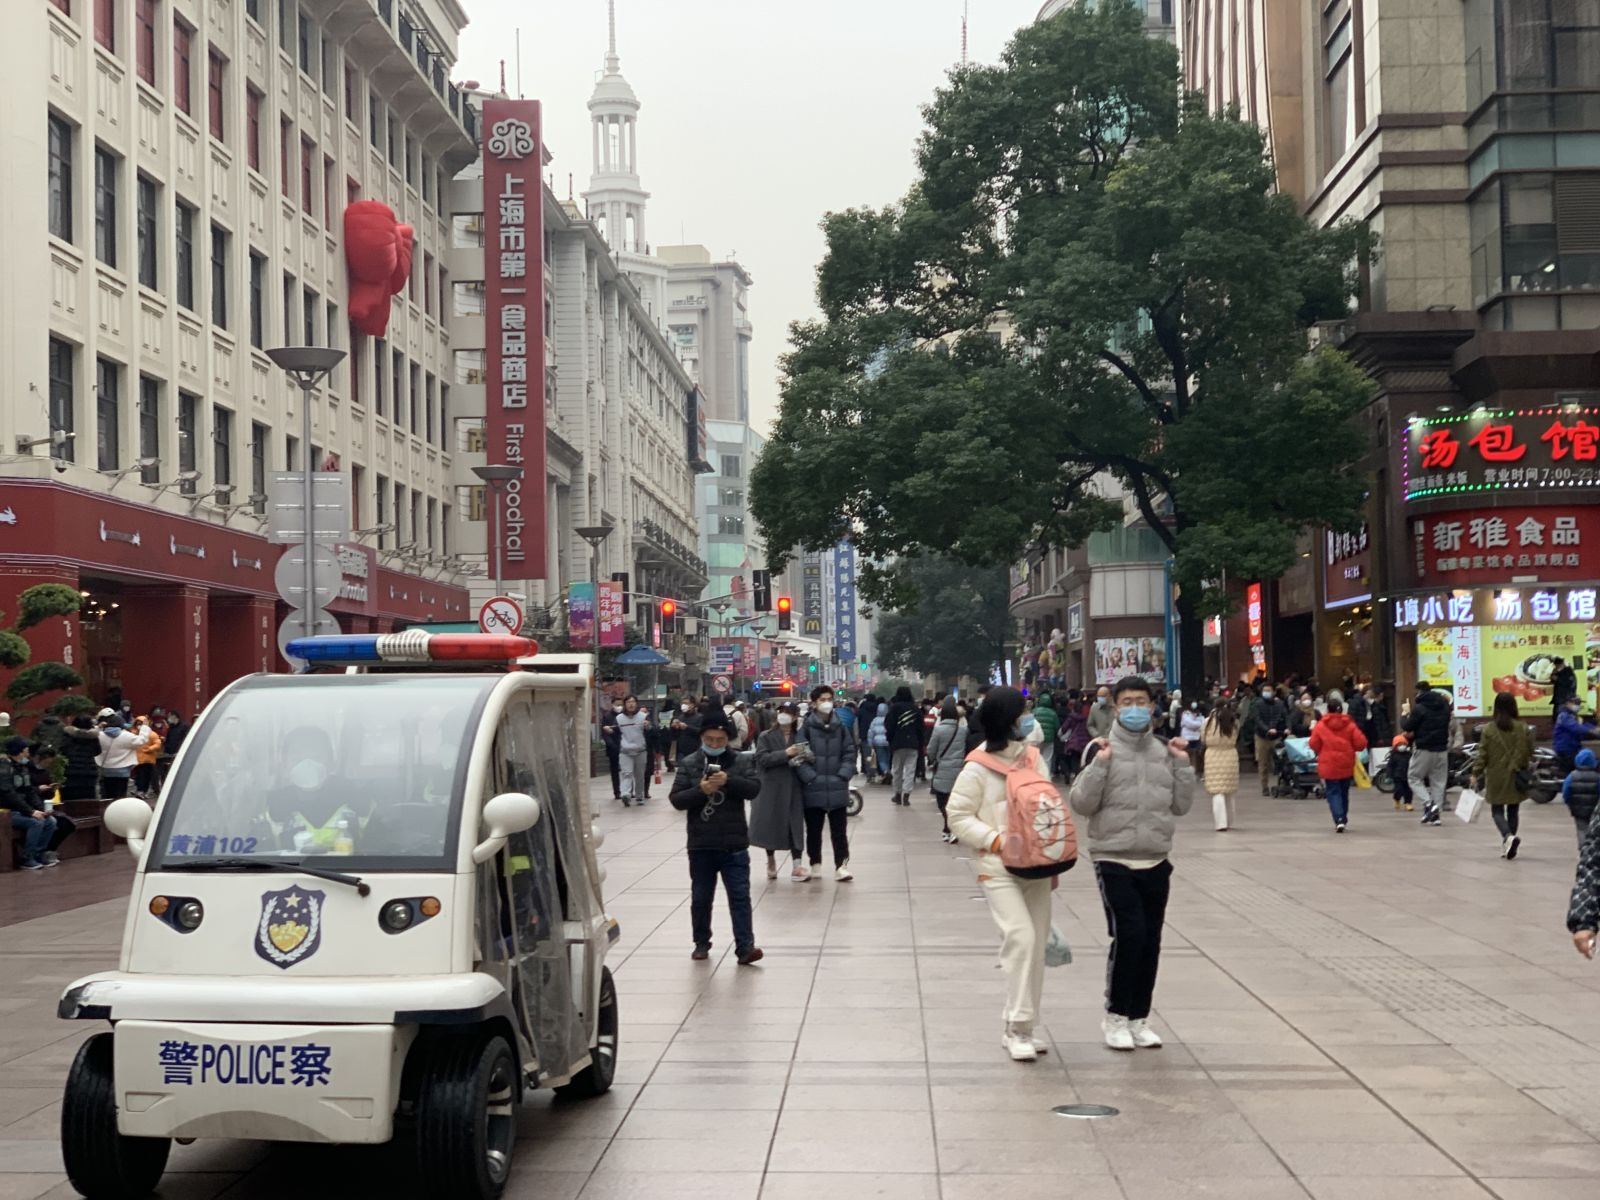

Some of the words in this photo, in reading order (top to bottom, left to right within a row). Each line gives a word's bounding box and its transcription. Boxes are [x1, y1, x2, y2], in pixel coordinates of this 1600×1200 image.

[500, 173, 527, 408] 上海市第一食品商店
[506, 423, 524, 463] First
[1418, 420, 1599, 468] 汤包馆
[506, 470, 525, 561] oodhall
[1433, 516, 1580, 551] 新雅食品
[1395, 594, 1474, 627] 上海小吃
[1494, 589, 1597, 621] 汤包馆
[1457, 626, 1472, 700] 上海小吃
[168, 834, 257, 855] 黄浦102
